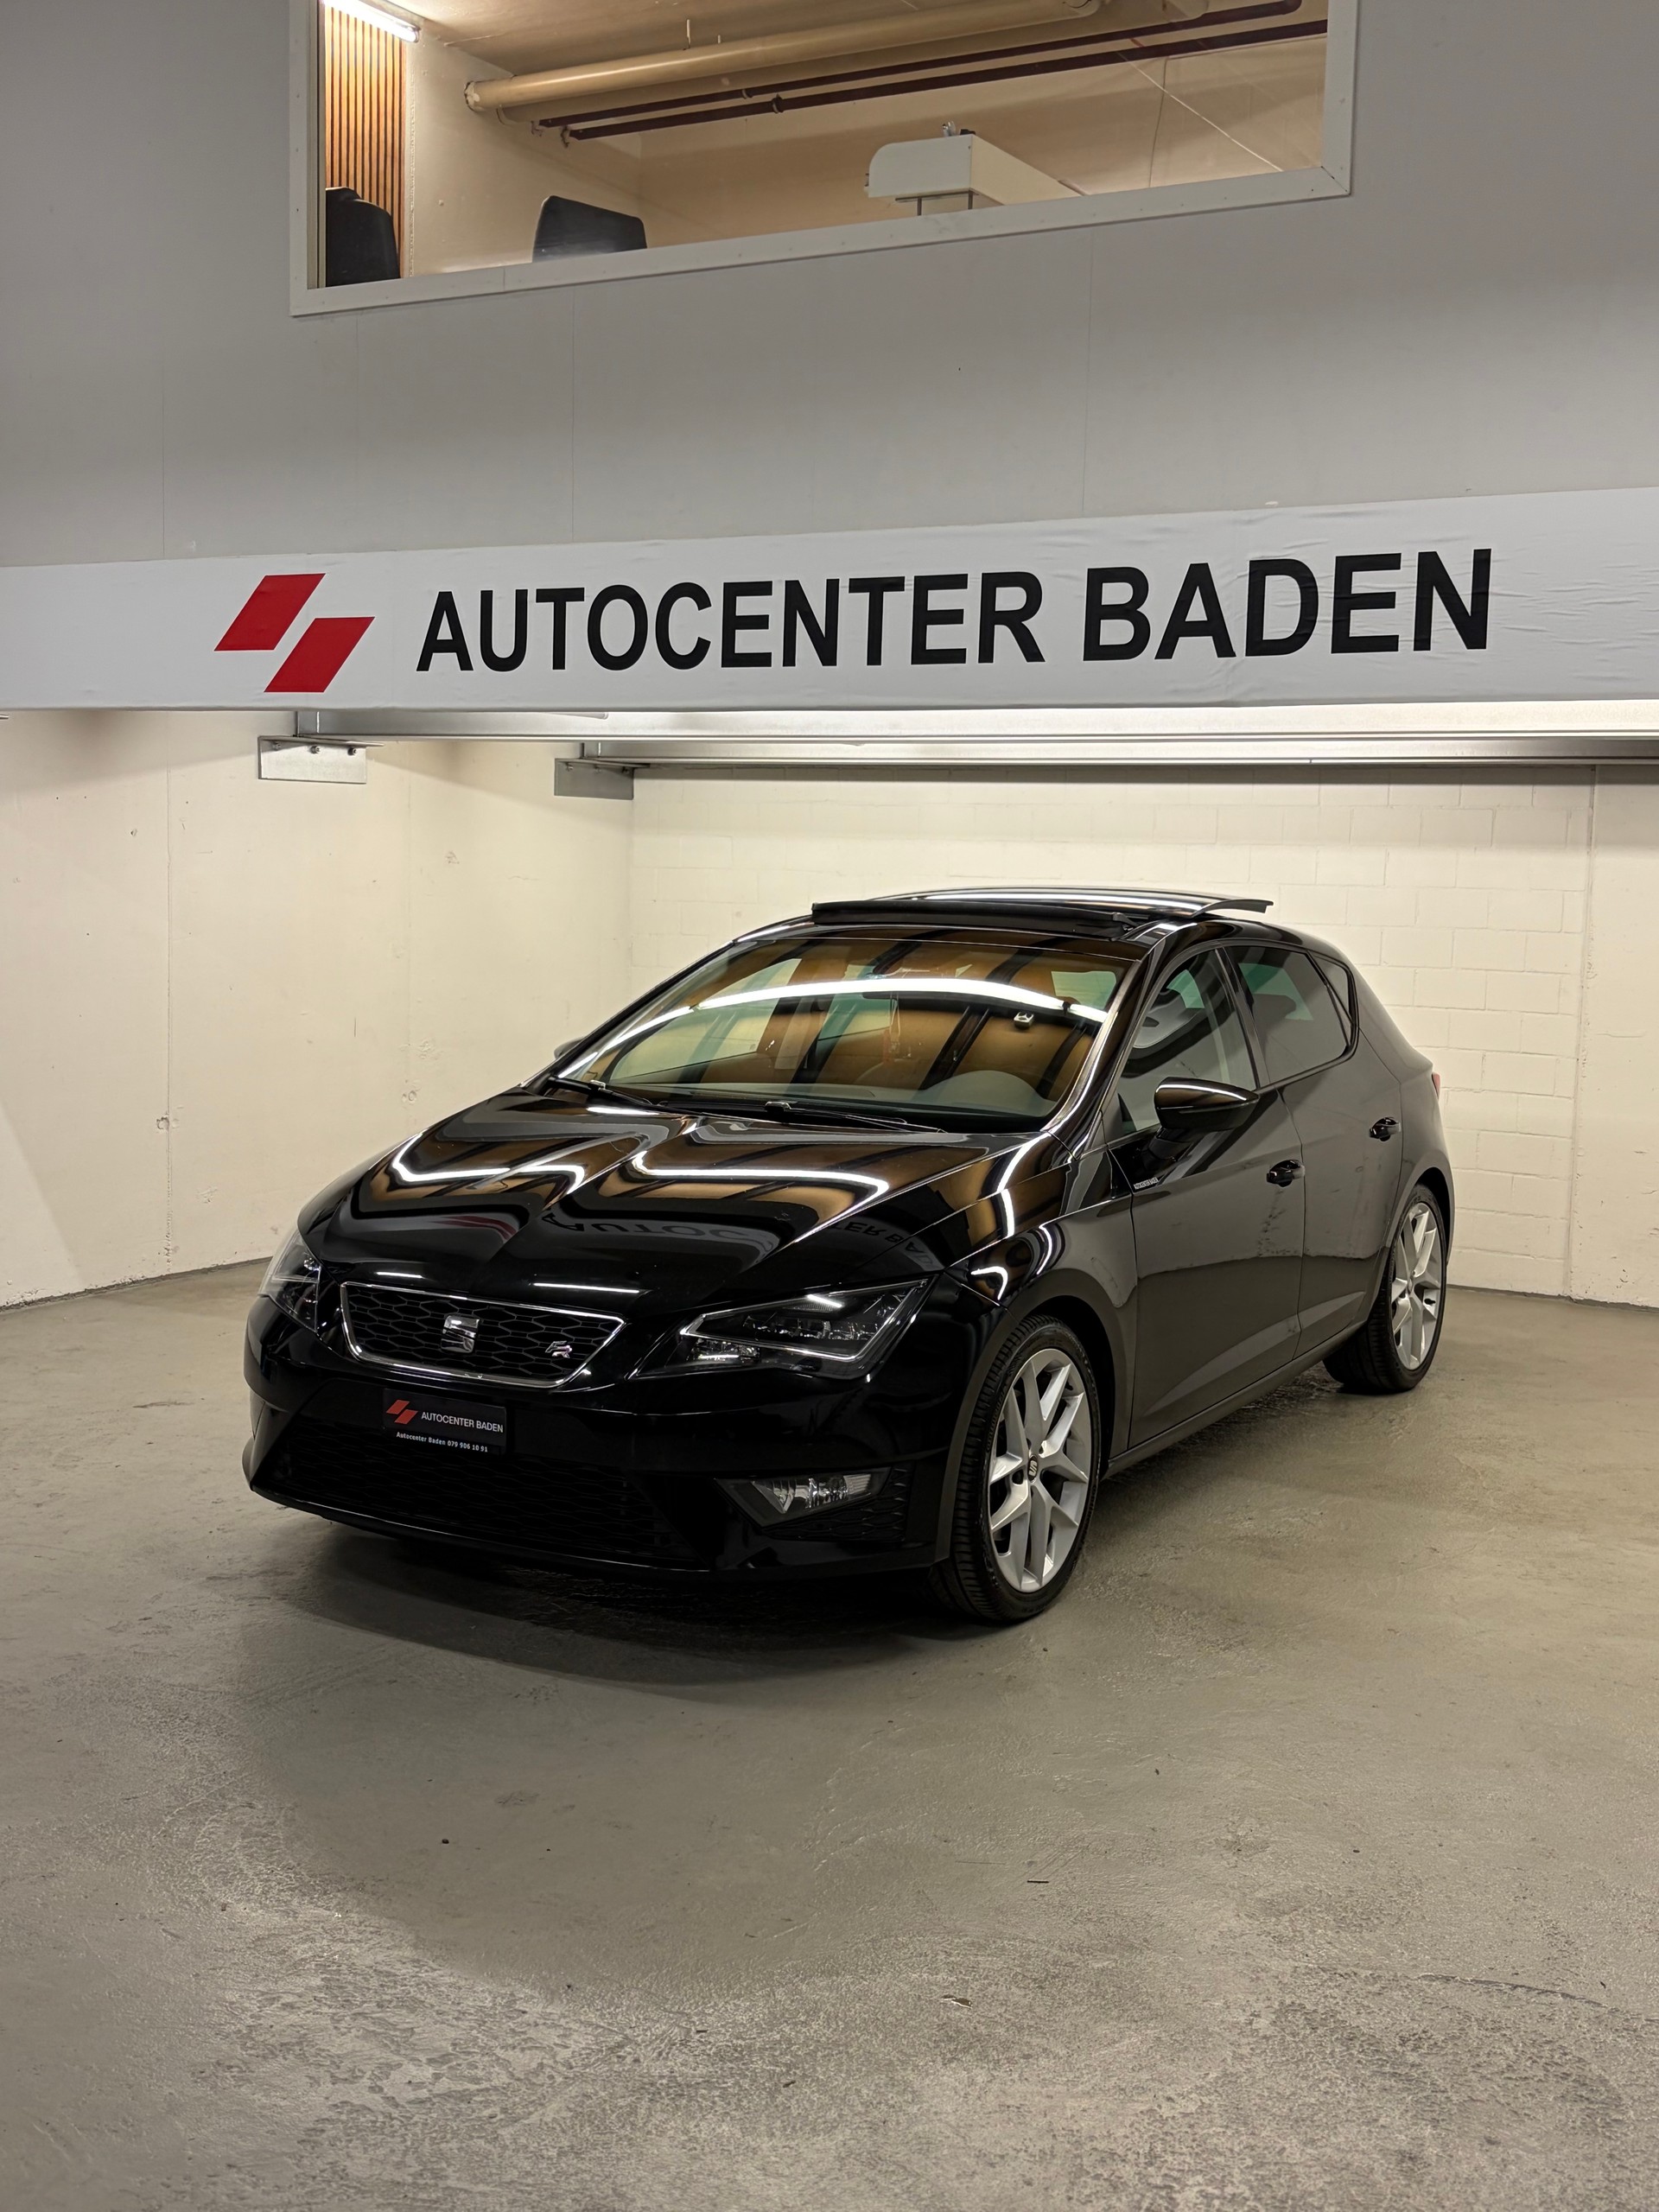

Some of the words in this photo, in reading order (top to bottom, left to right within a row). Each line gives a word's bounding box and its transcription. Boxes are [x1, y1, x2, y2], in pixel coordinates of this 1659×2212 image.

[416, 572, 1045, 671] AUTOCENTER
[1084, 549, 1491, 661] BADEN
[544, 1340, 572, 1358] FR
[421, 1411, 474, 1428] AUTOCENTER
[476, 1421, 503, 1433] BADEN
[396, 1431, 427, 1442] Autocenter
[429, 1437, 446, 1446] Baden
